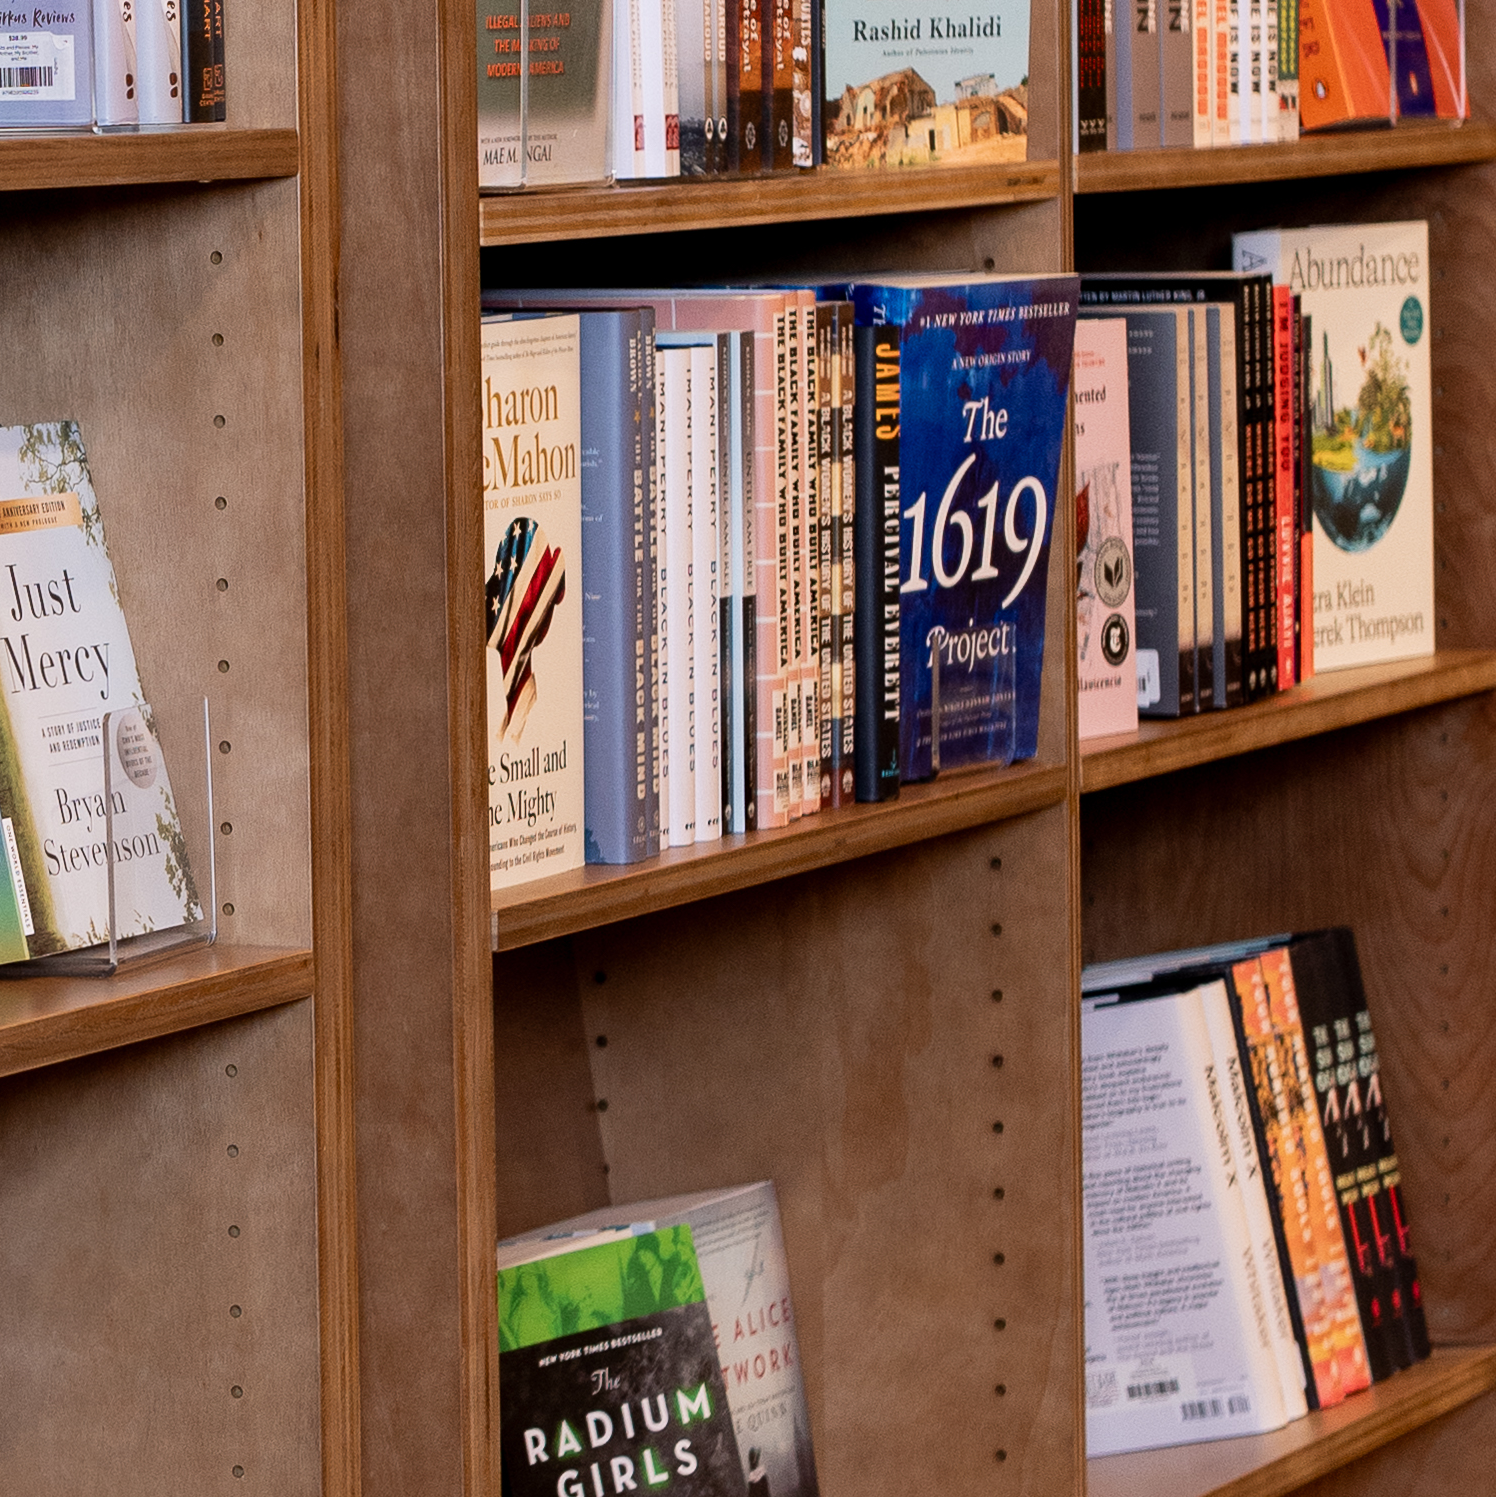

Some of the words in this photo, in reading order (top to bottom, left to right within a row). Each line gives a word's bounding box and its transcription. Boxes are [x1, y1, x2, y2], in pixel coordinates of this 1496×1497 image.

[852, 19, 921, 42] Rashid
[929, 16, 1002, 38] Khalidi
[1288, 246, 1421, 291] Abundance
[934, 312, 957, 327] NEW
[960, 312, 984, 326] YORK
[988, 307, 1015, 322] TIMES
[1019, 302, 1070, 319] BESTSELLER
[876, 342, 901, 442] JAMES
[962, 396, 1008, 443] The
[883, 465, 901, 595] PERCIVAL
[900, 454, 1048, 611] 1619
[5, 562, 82, 623] Just
[0, 633, 112, 701] Mercy
[884, 602, 900, 721] EVERETT
[497, 753, 540, 785] Small
[543, 746, 568, 774] and
[54, 787, 128, 834] Bryan
[507, 789, 557, 836] Mighty
[43, 827, 163, 877] Stevenson
[1204, 1064, 1232, 1167] Malcolm
[1225, 1172, 1239, 1189] X
[523, 1382, 712, 1466] RADIUM
